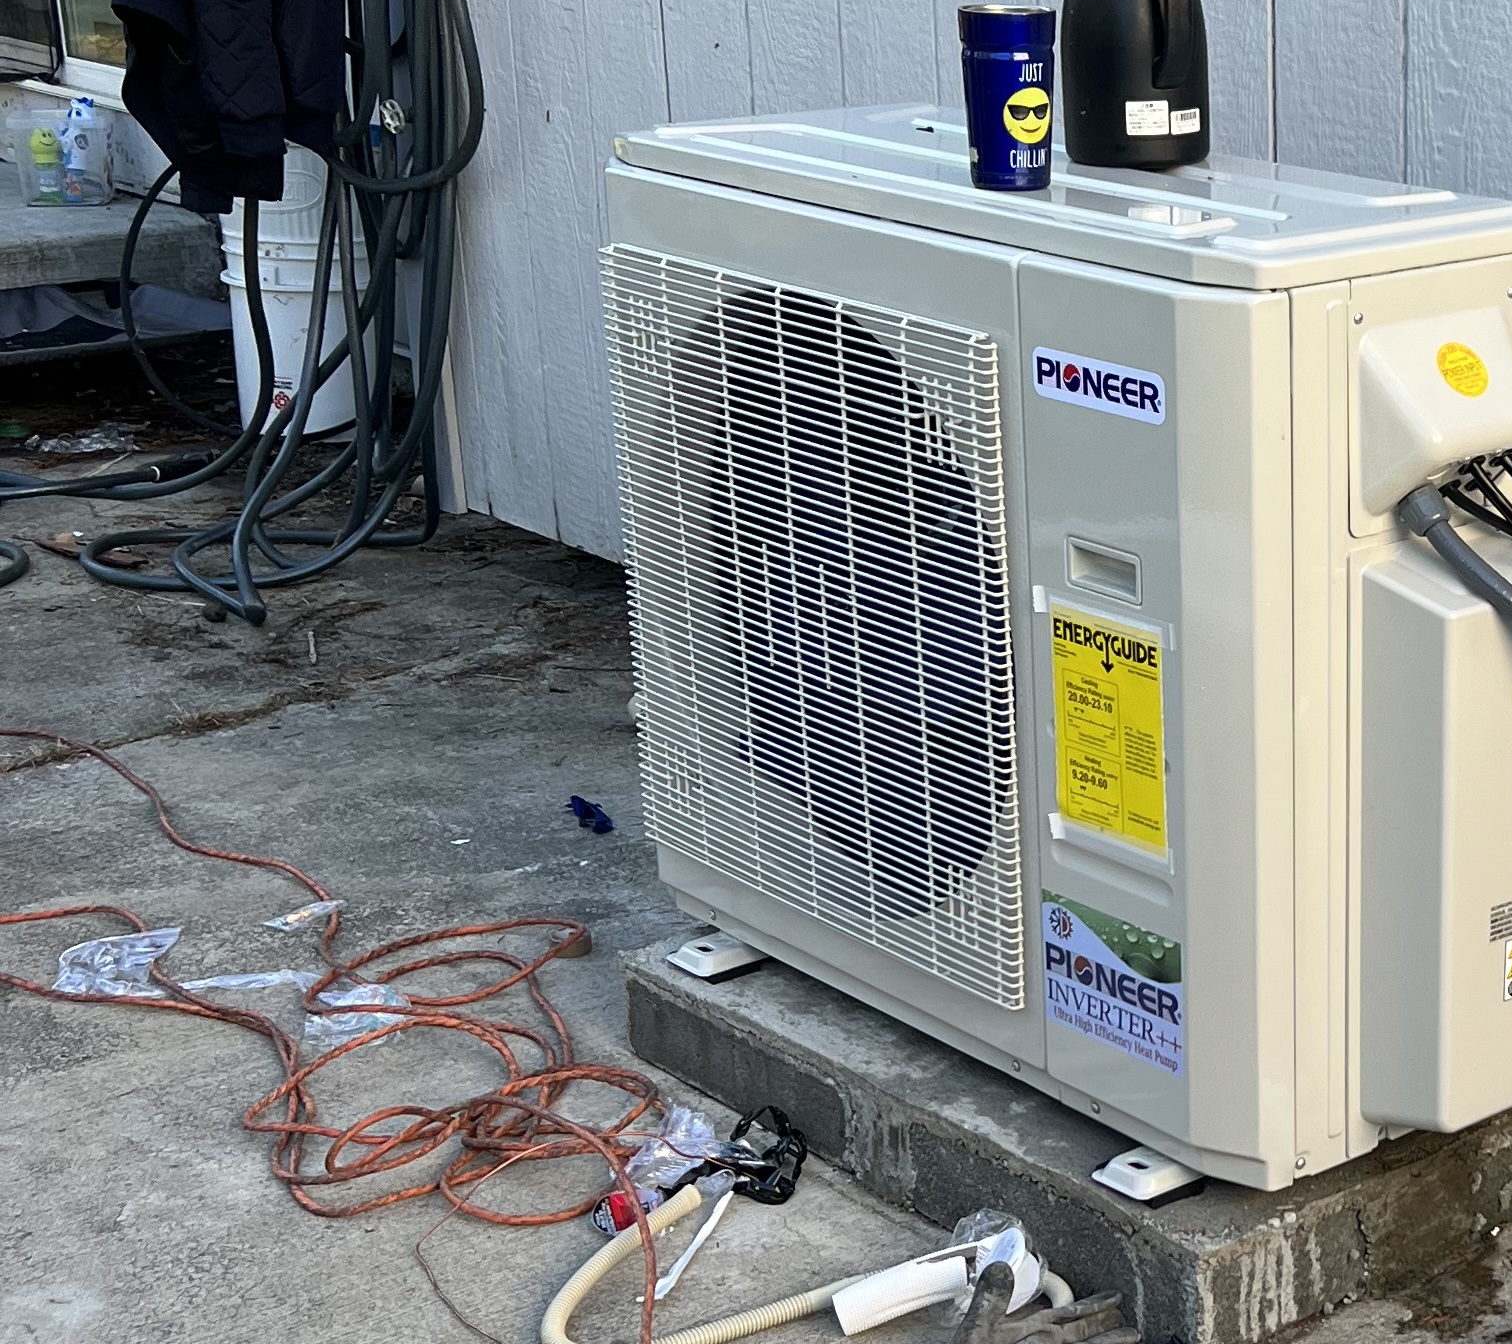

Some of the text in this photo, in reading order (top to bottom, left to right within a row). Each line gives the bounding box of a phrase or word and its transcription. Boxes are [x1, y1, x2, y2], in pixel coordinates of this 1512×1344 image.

[1018, 62, 1043, 82] JUST
[1036, 355, 1161, 413] PIONEER
[1053, 617, 1158, 669] ENERGYGUIDE
[1045, 941, 1180, 1026] PIONEER
[1053, 1006, 1178, 1072] Ultra High Efficiency Heat Pump
